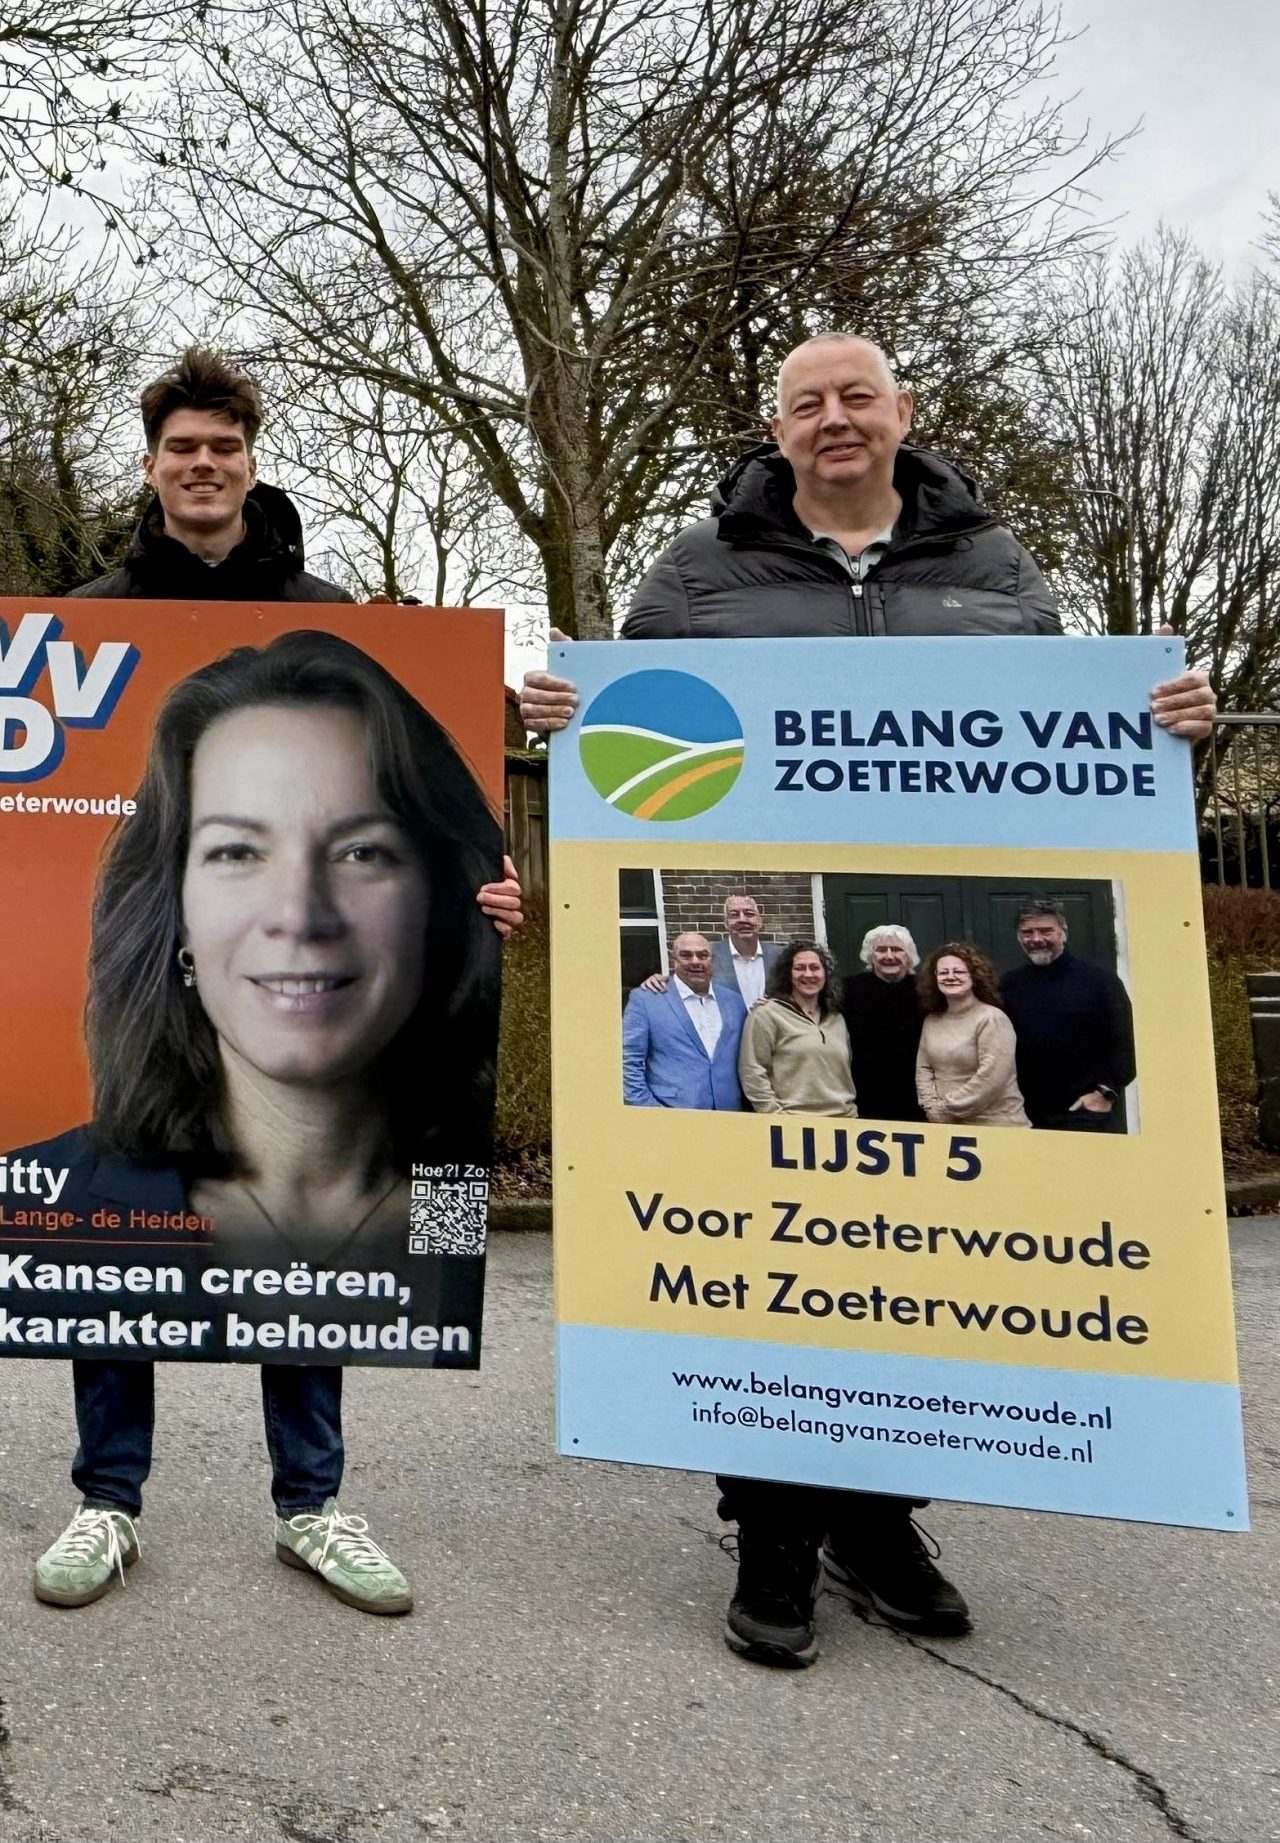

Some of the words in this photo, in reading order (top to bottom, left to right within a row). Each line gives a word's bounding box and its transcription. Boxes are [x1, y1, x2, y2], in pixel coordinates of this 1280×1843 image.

[774, 709, 1004, 749] BELANG
[1018, 711, 1153, 750] VAN
[774, 759, 1157, 798] ZOETERWOUDE
[769, 1125, 925, 1178] LIJST
[946, 1136, 982, 1182] 5
[0, 1205, 84, 1231] Lange-
[91, 1208, 120, 1229] de
[129, 1209, 216, 1233] Heiden
[625, 1191, 753, 1240] Voor
[770, 1201, 1152, 1271] Zoeterwoude
[201, 1262, 412, 1306] creëren,
[649, 1263, 750, 1310] Met
[766, 1272, 1150, 1346] Zoeterwoude
[225, 1311, 471, 1353] behouden
[672, 1369, 1113, 1431] www.belangvanzoeterwoude.nl
[692, 1403, 1094, 1465] info@belangvanzoeterwoude.nl
